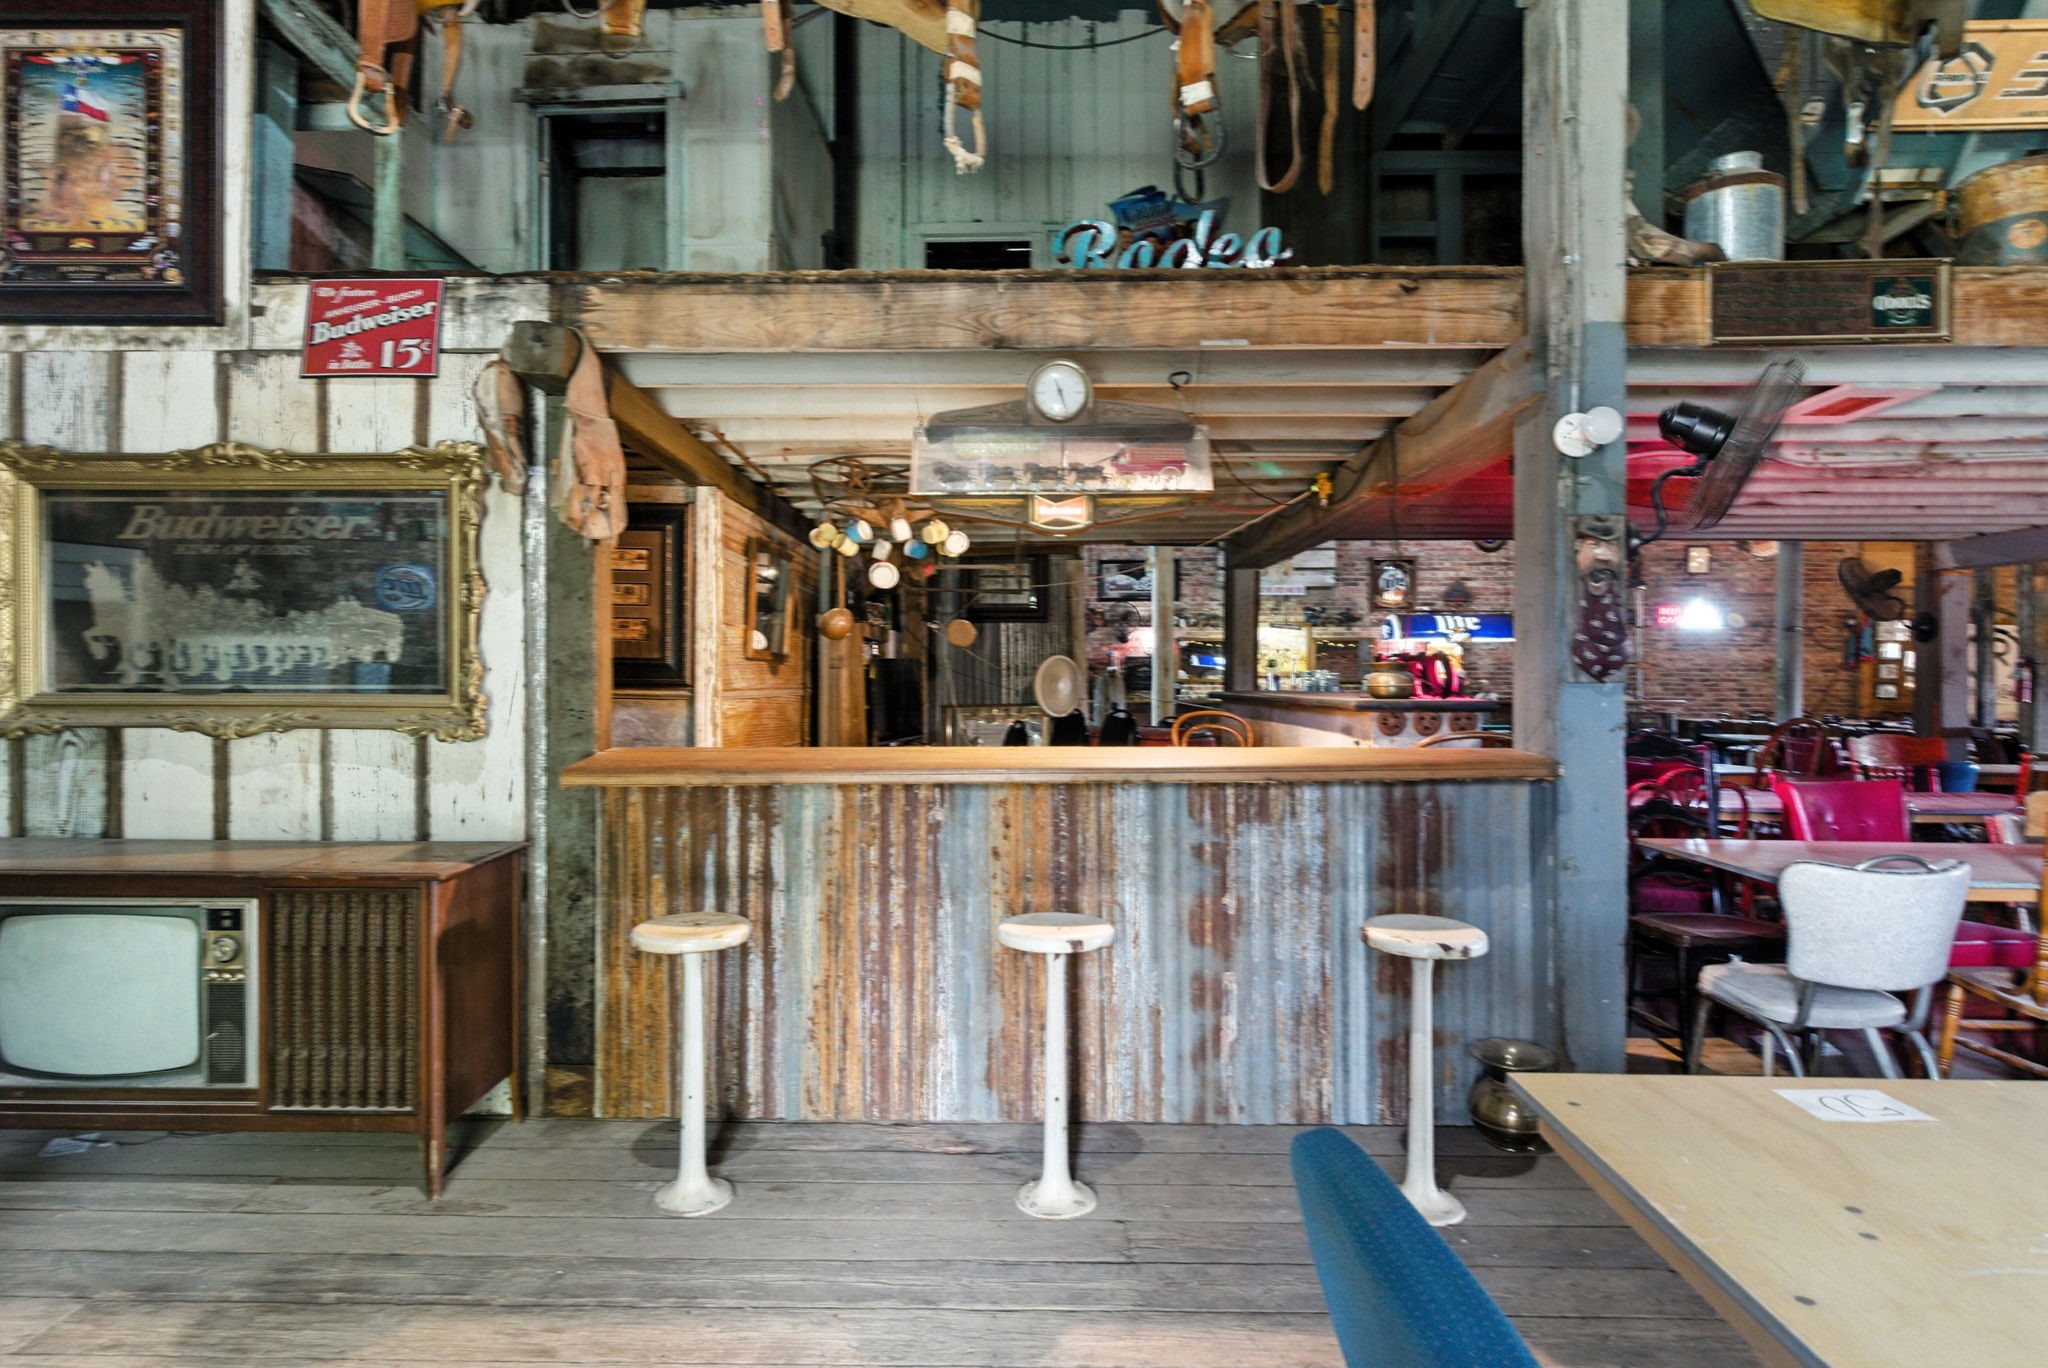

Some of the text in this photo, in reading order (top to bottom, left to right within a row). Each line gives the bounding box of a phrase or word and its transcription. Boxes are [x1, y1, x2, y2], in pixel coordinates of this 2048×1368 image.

[1052, 209, 1293, 268] Rodeo
[309, 301, 438, 346] Budweiser
[117, 505, 375, 541] Budweiser
